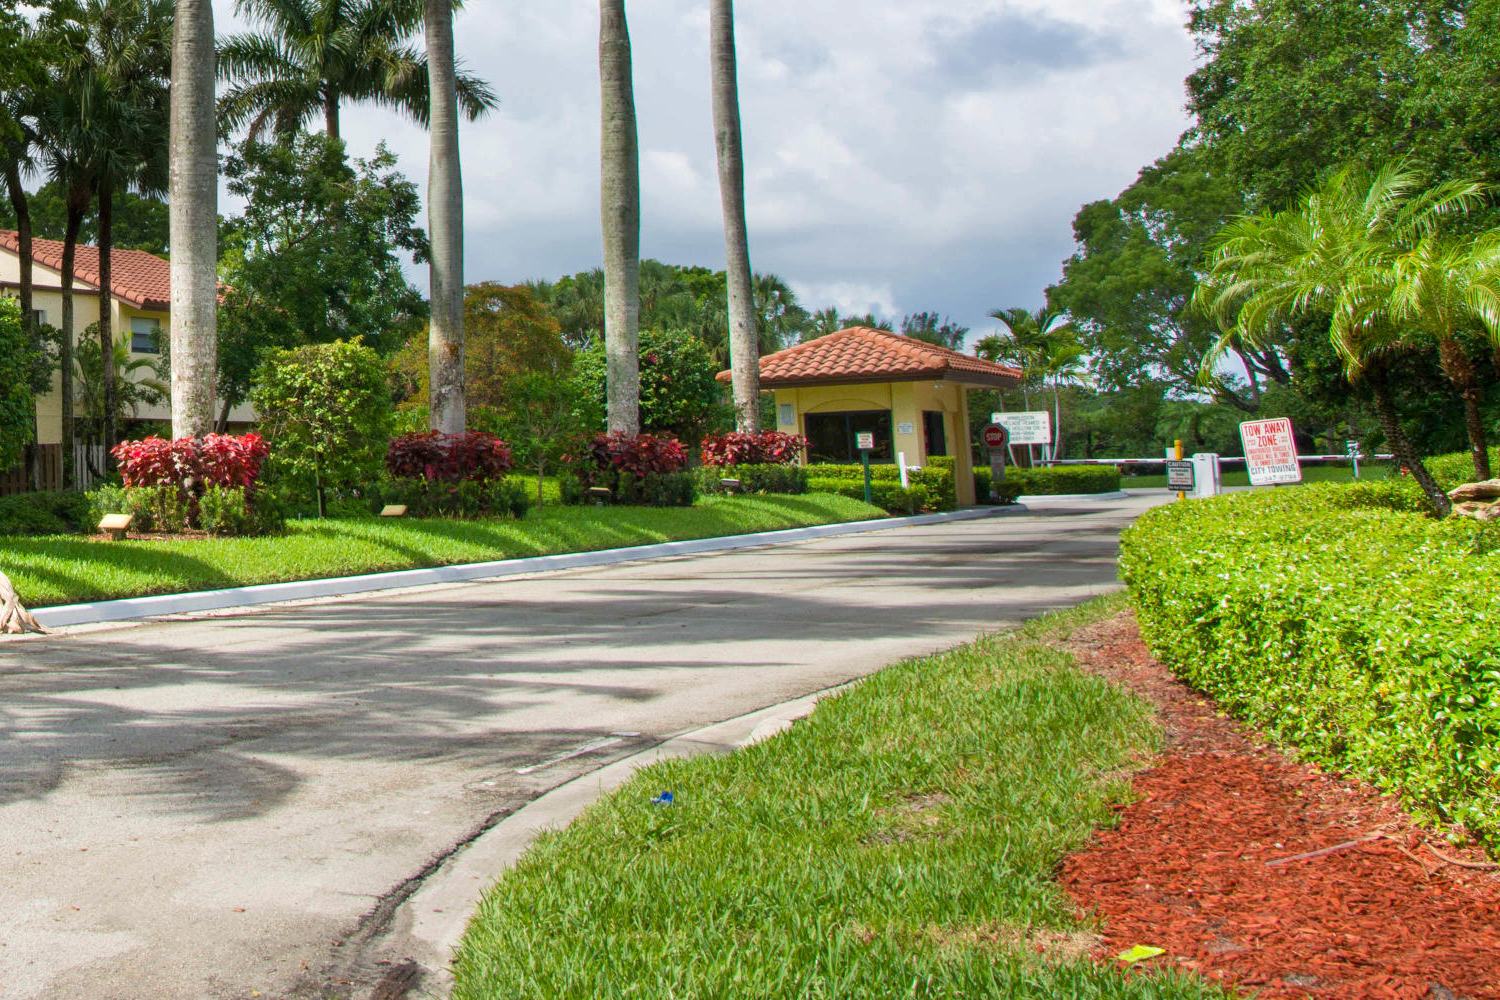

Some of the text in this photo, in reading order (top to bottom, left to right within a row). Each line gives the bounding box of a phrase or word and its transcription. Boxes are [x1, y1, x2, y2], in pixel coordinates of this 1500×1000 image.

[1244, 421, 1286, 437] TOW AWAY
[987, 432, 1001, 441] STOP
[1257, 435, 1278, 447] ZONE
[1251, 464, 1296, 475] CITY TOWING
